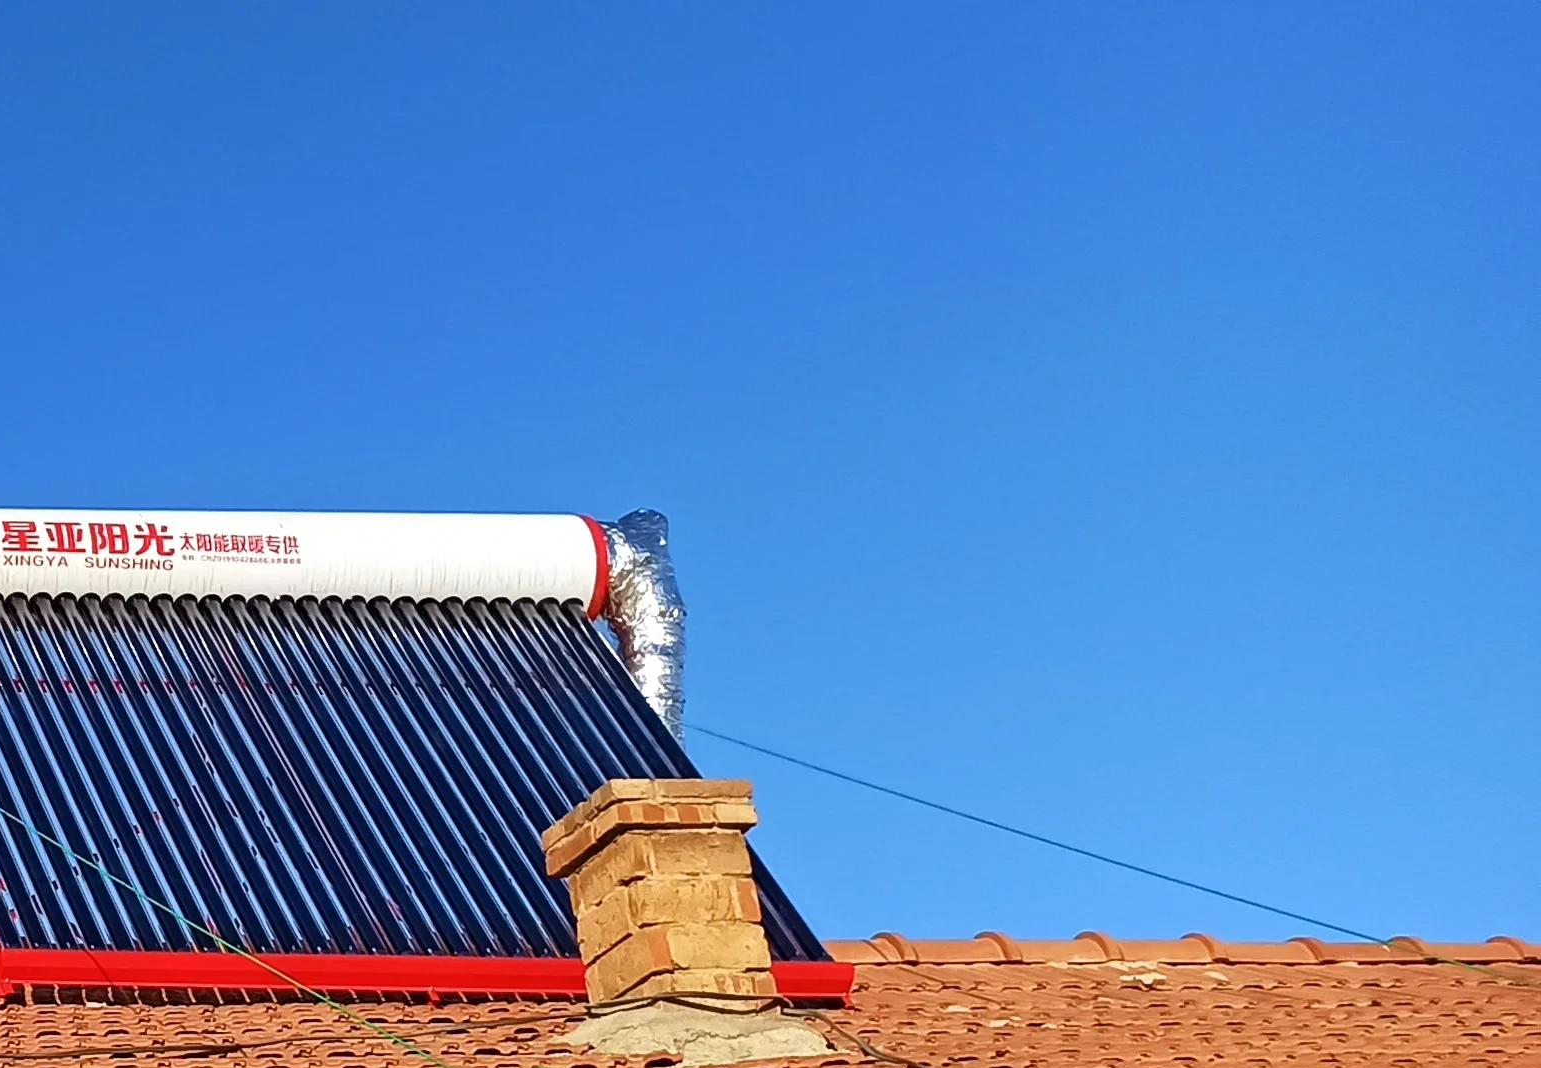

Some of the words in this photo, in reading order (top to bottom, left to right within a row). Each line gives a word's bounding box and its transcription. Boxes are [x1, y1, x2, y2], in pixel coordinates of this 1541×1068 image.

[2, 520, 175, 556] 星亚阳光
[179, 532, 301, 555] 太阳能取暖专供
[3, 555, 69, 567] XINGYA
[84, 556, 174, 571] SUNSHING
